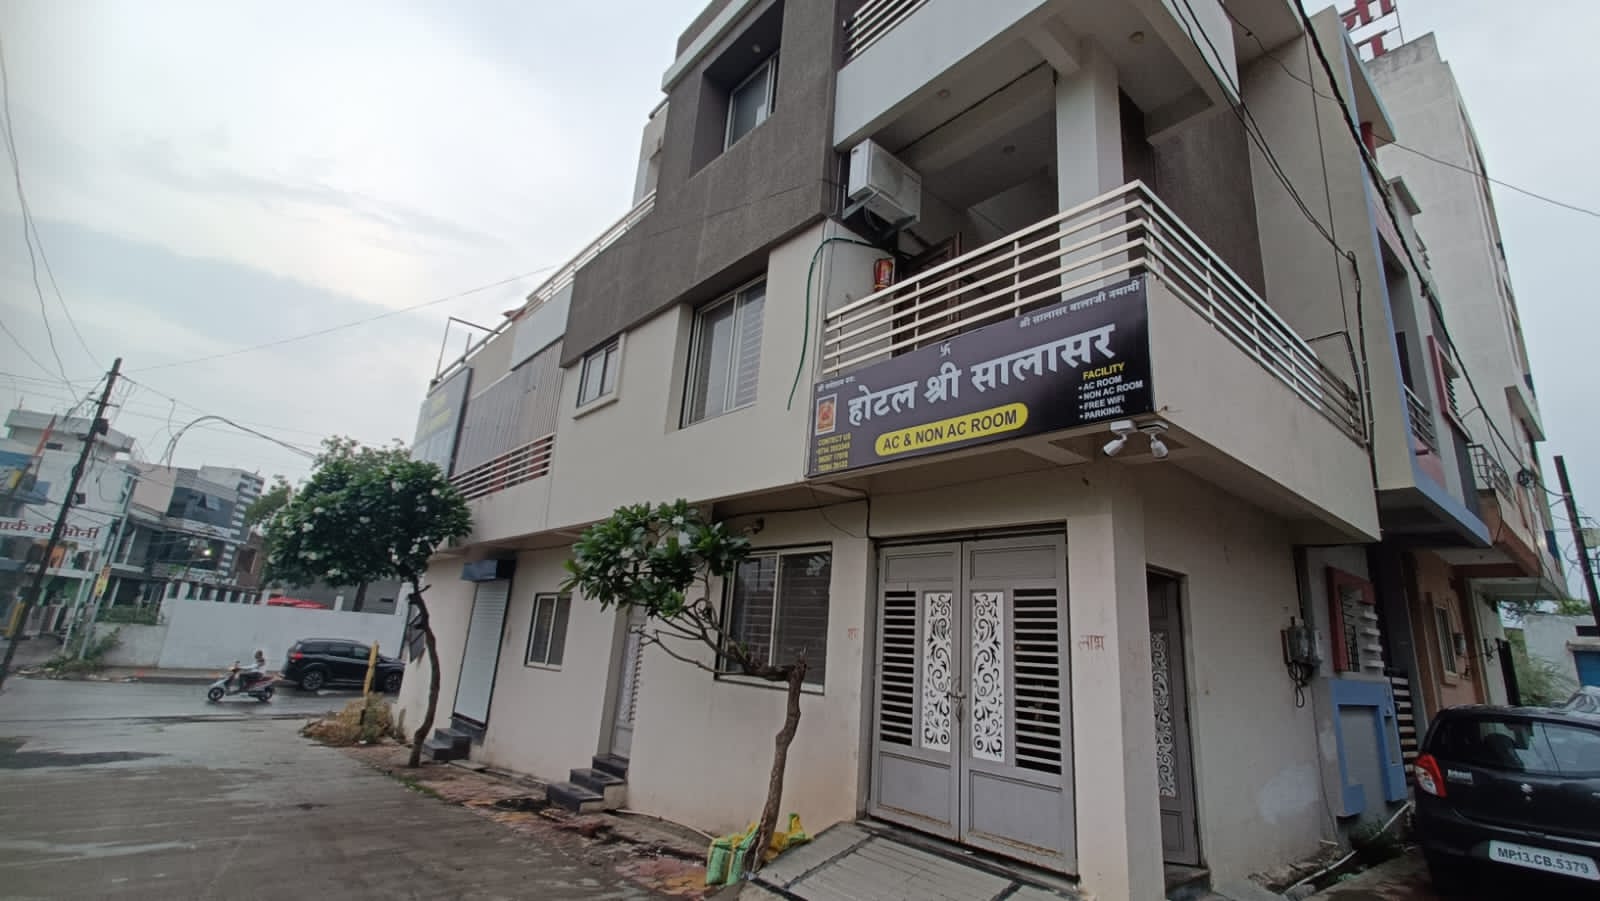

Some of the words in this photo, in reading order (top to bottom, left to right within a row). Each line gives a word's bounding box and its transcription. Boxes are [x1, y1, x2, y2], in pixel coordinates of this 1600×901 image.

[847, 381, 919, 426] होटल
[923, 361, 962, 404] श्री
[970, 323, 1116, 392] सालासर
[1083, 362, 1125, 379] FACILITY
[1083, 382, 1095, 391] AC
[1096, 375, 1122, 388] ROOM
[1083, 390, 1101, 400] NON
[1103, 387, 1115, 396] AC
[1116, 380, 1143, 393] ROOM
[1084, 399, 1105, 410] FREE
[883, 437, 899, 451] AC
[903, 433, 912, 447] &
[915, 426, 943, 444] NON
[947, 421, 967, 438] AC
[971, 409, 1017, 432] ROOM
